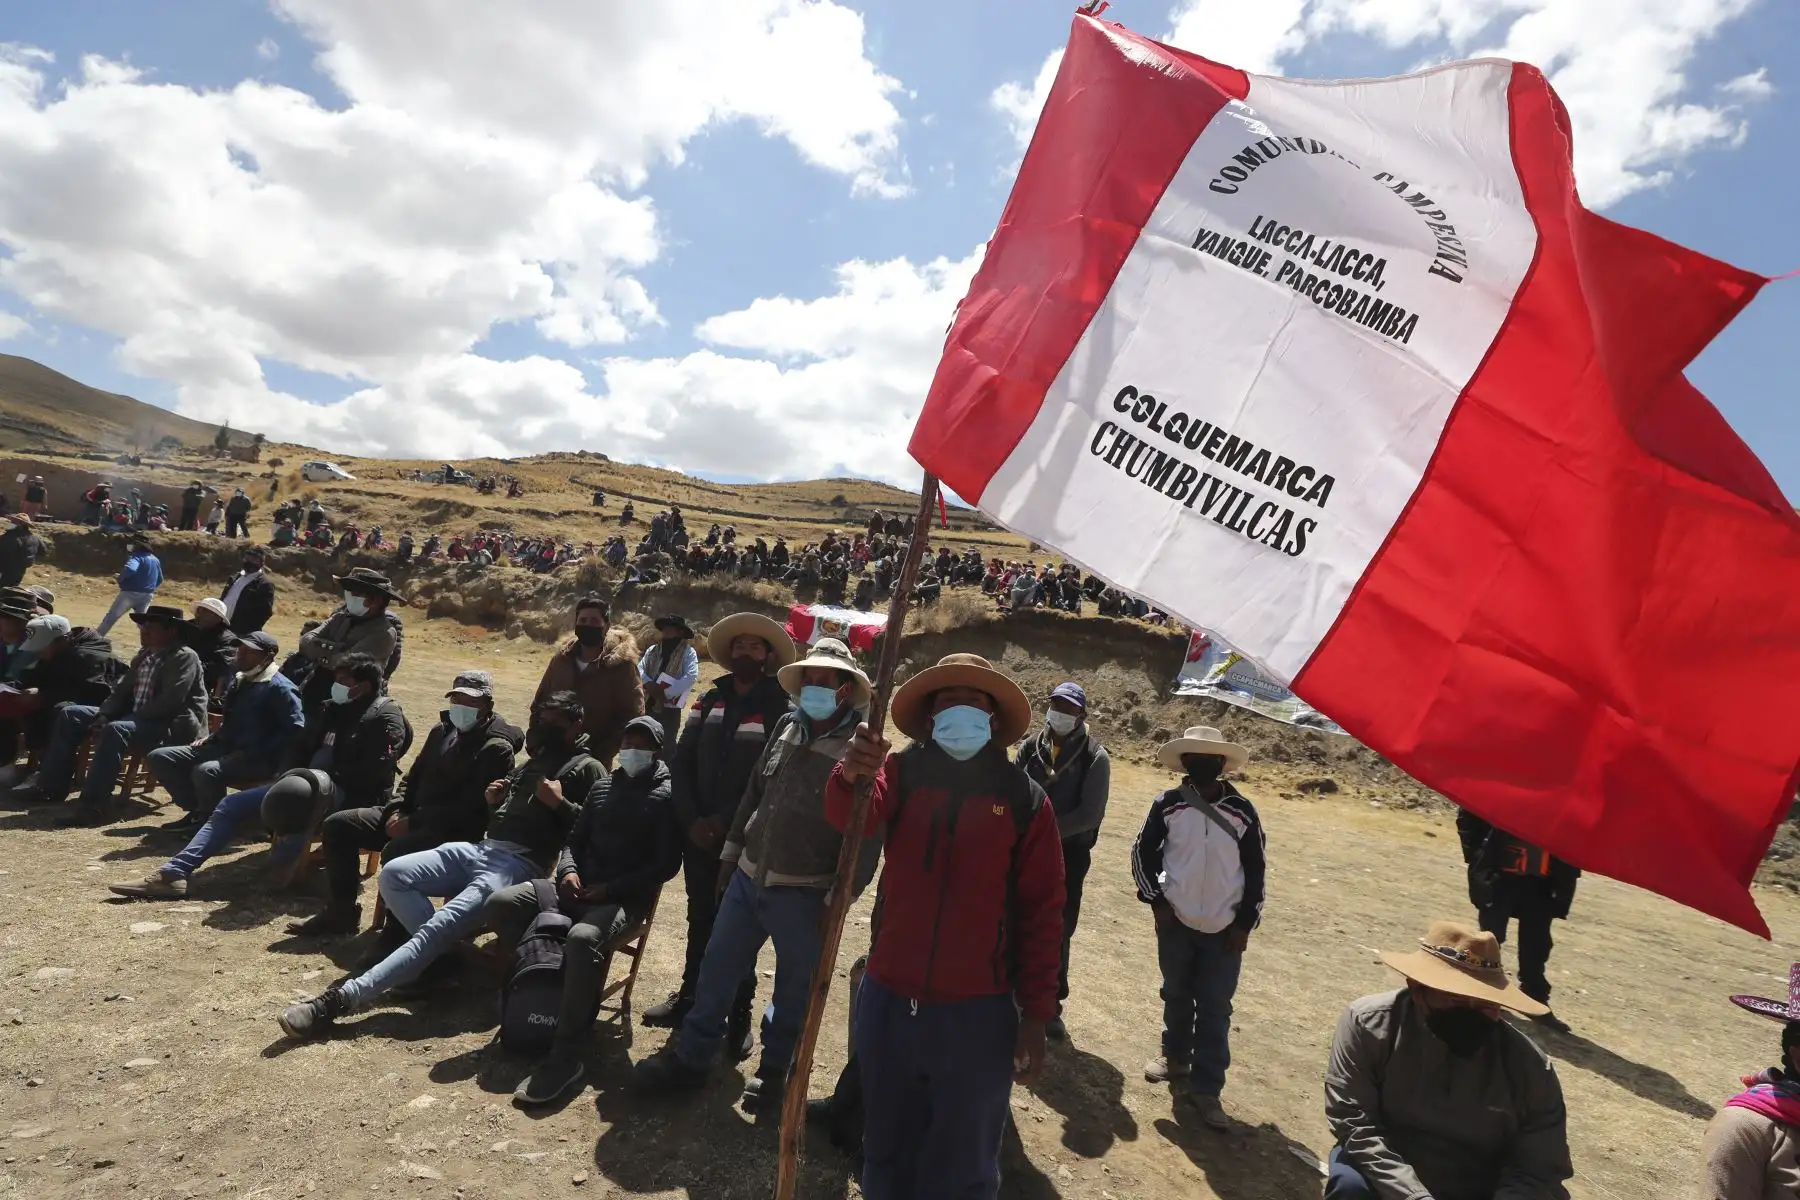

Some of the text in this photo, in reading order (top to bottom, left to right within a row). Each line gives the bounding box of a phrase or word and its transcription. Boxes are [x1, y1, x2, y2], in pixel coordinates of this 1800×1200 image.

[1208, 135, 1361, 195] COMUNID
[1191, 228, 1420, 345] YANQUE, PARCOBAMBA
[1090, 420, 1318, 557] CHUMBIVILCAS
[1113, 385, 1336, 508] COLQUEMARCA
